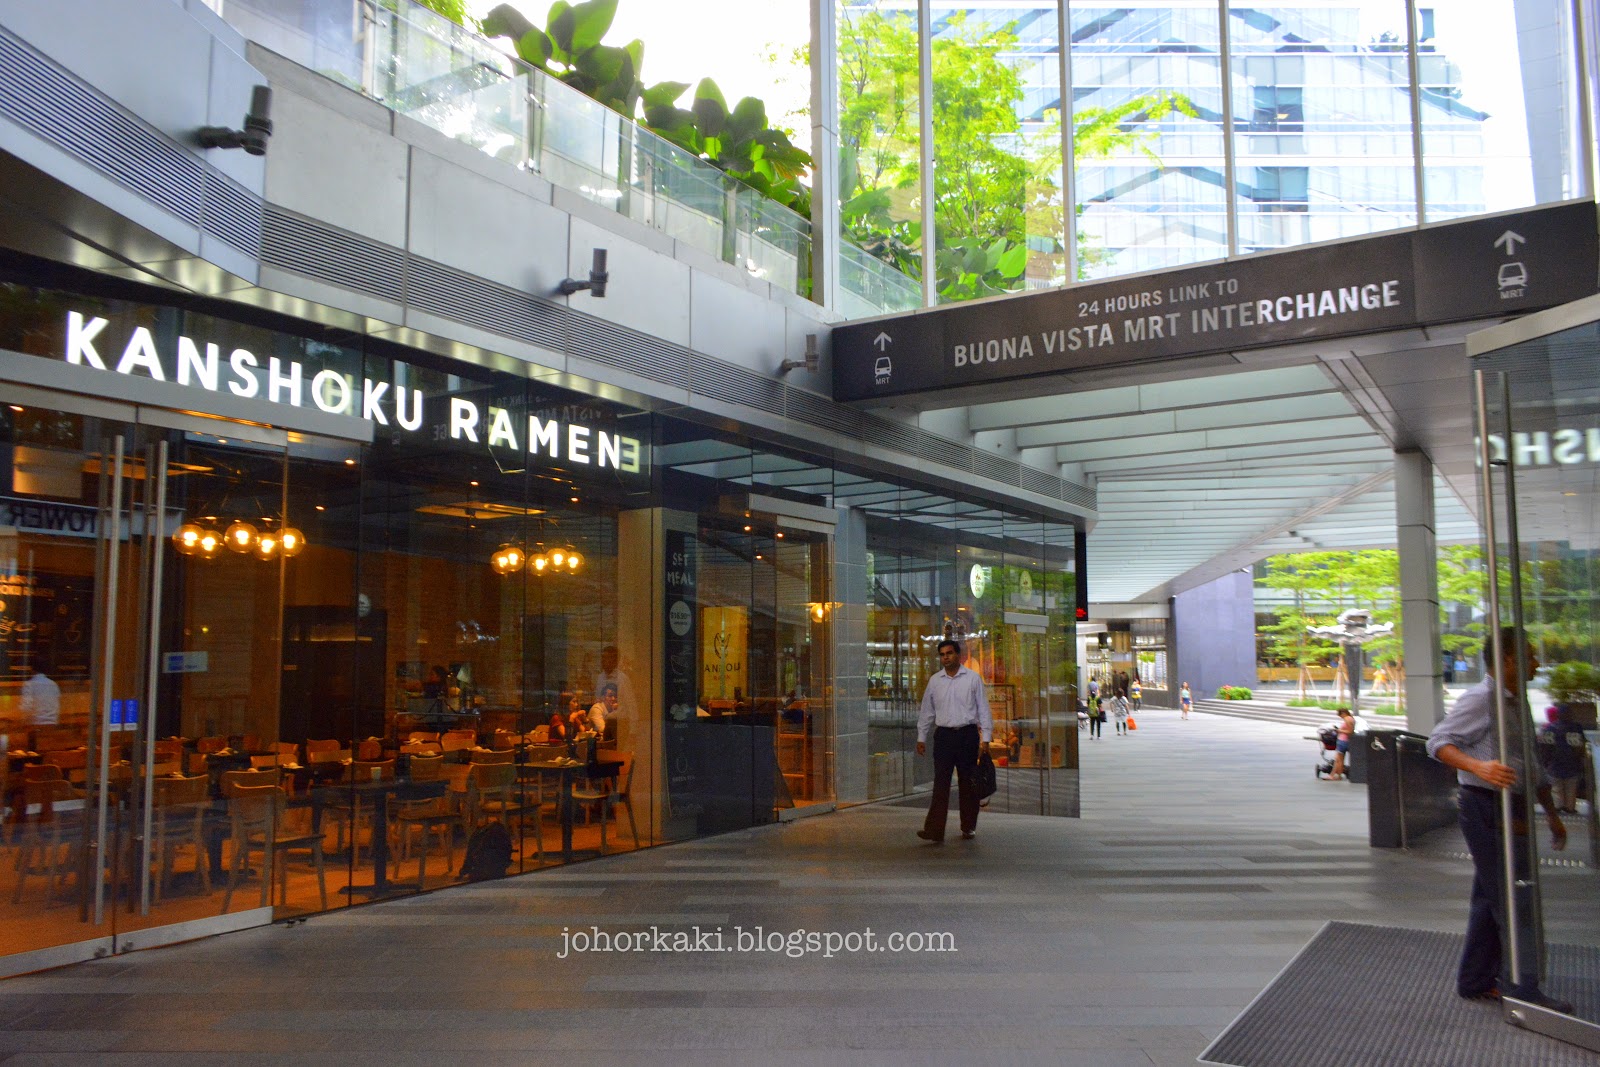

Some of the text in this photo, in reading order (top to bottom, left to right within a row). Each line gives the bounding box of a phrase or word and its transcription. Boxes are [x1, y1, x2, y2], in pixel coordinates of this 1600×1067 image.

[1078, 278, 1239, 318] 24 HOURS LINK TO
[1500, 288, 1525, 300] MRT
[954, 280, 1401, 367] BUONA VISTA MRT INTERCHANGE
[875, 376, 891, 386] MRT
[66, 310, 620, 470] KANSHOKU RAMEN
[672, 552, 689, 566] SET
[667, 571, 694, 587] MEAL
[704, 662, 741, 672] ANOU
